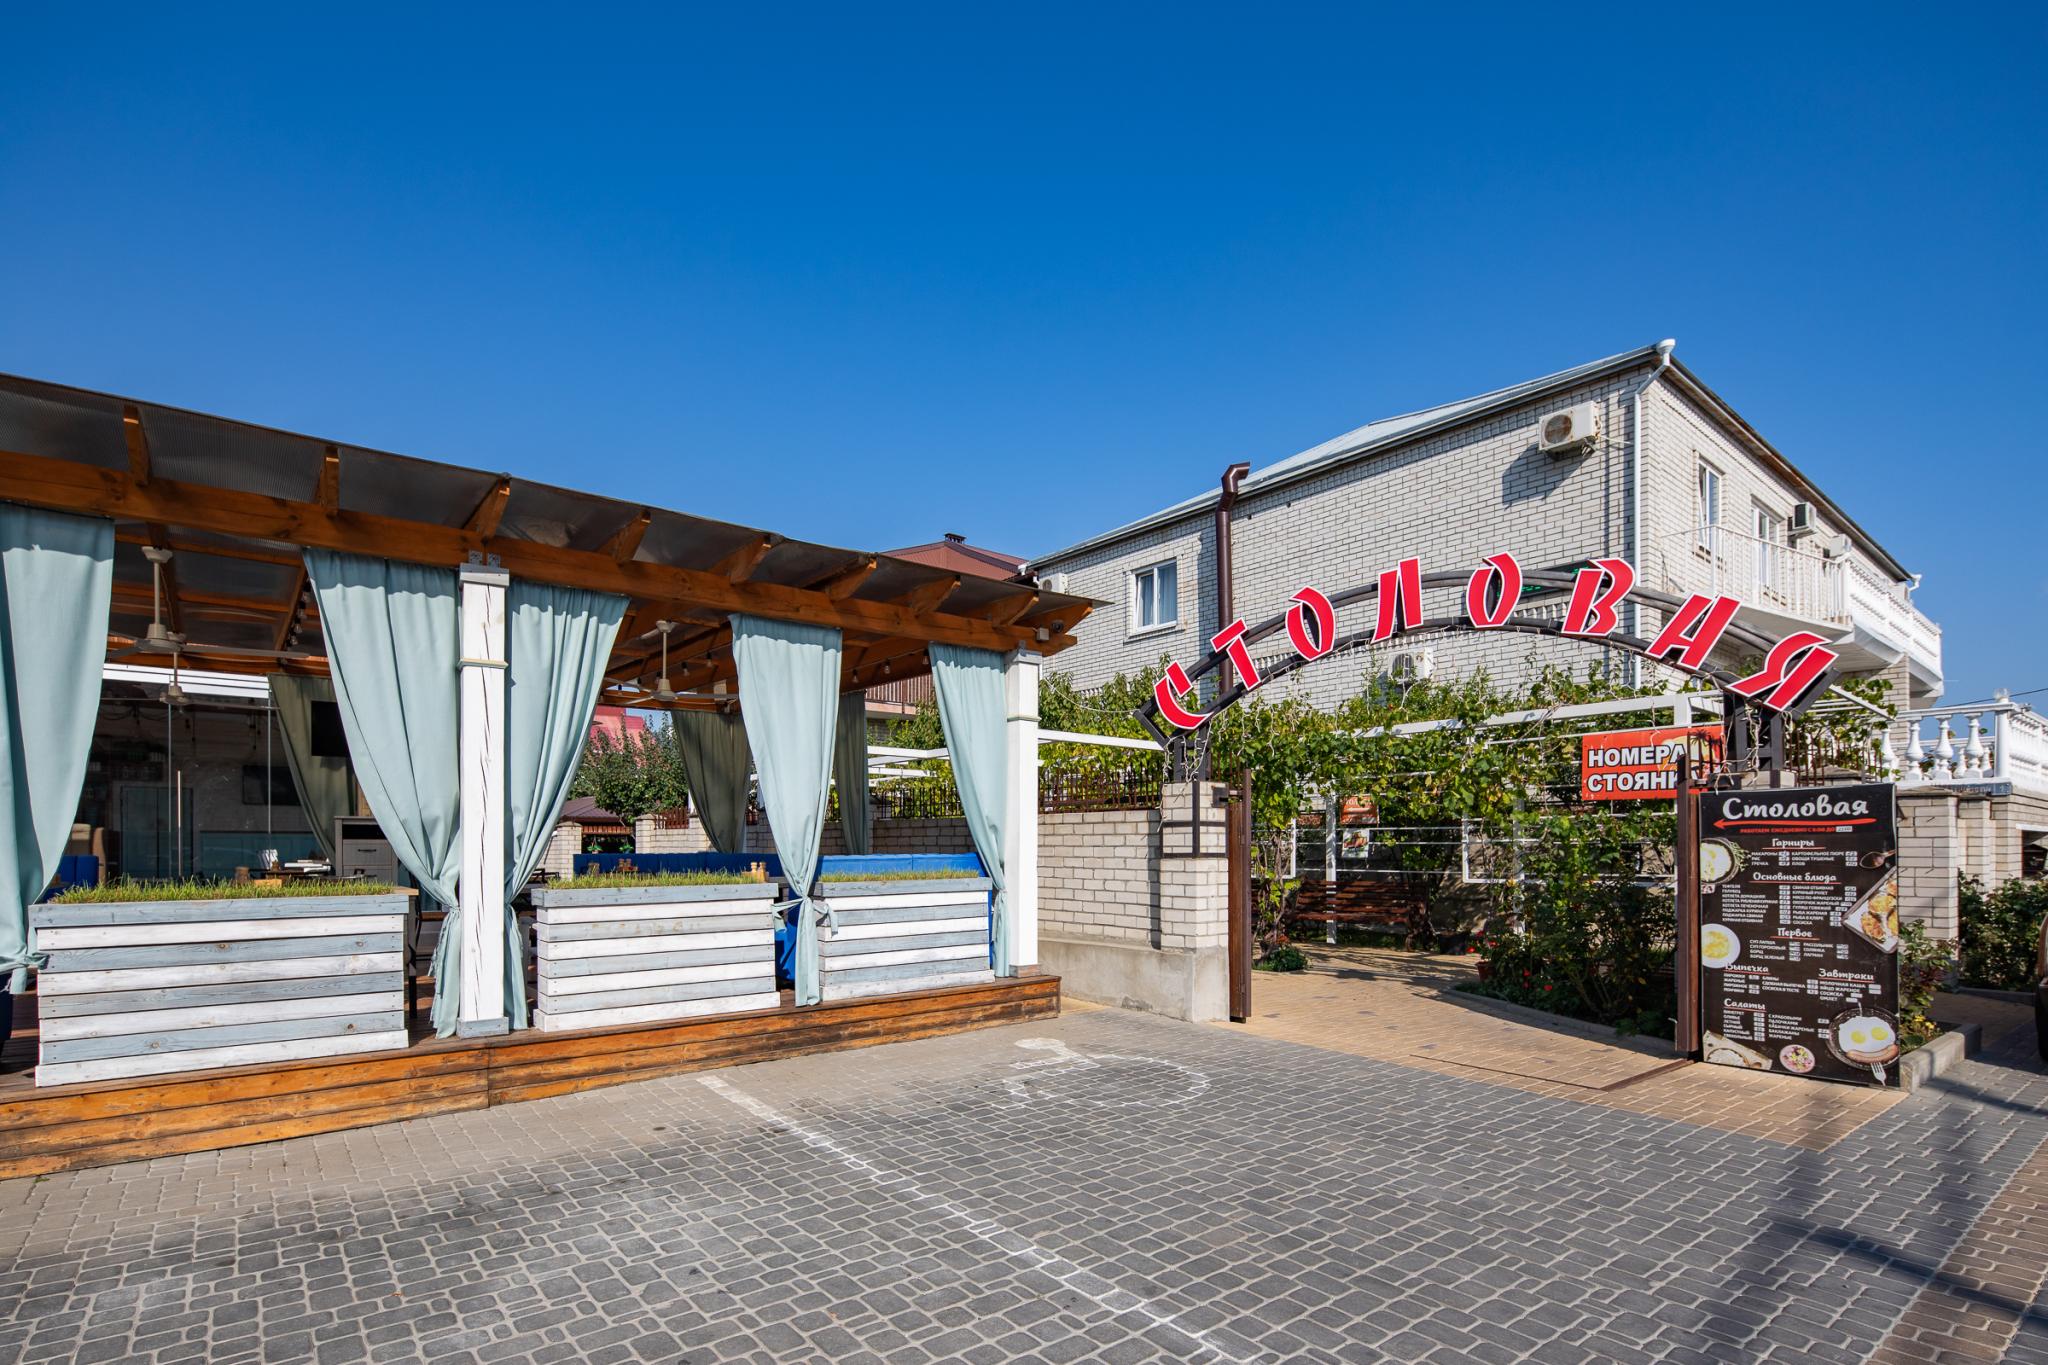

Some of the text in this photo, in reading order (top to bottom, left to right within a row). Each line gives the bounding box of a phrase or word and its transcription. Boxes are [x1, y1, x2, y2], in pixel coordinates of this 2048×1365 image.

[1154, 551, 1840, 730] СТОЛОВАЯ
[1587, 769, 1699, 793] СТОЯНК
[1722, 794, 1869, 820] Столовая
[1772, 838, 1814, 849] Гарниры
[1753, 872, 1836, 884] Основные блюда
[1777, 927, 1813, 938] Первое
[1818, 968, 1874, 981] Завтраки
[1724, 998, 1766, 1010] Салаты
